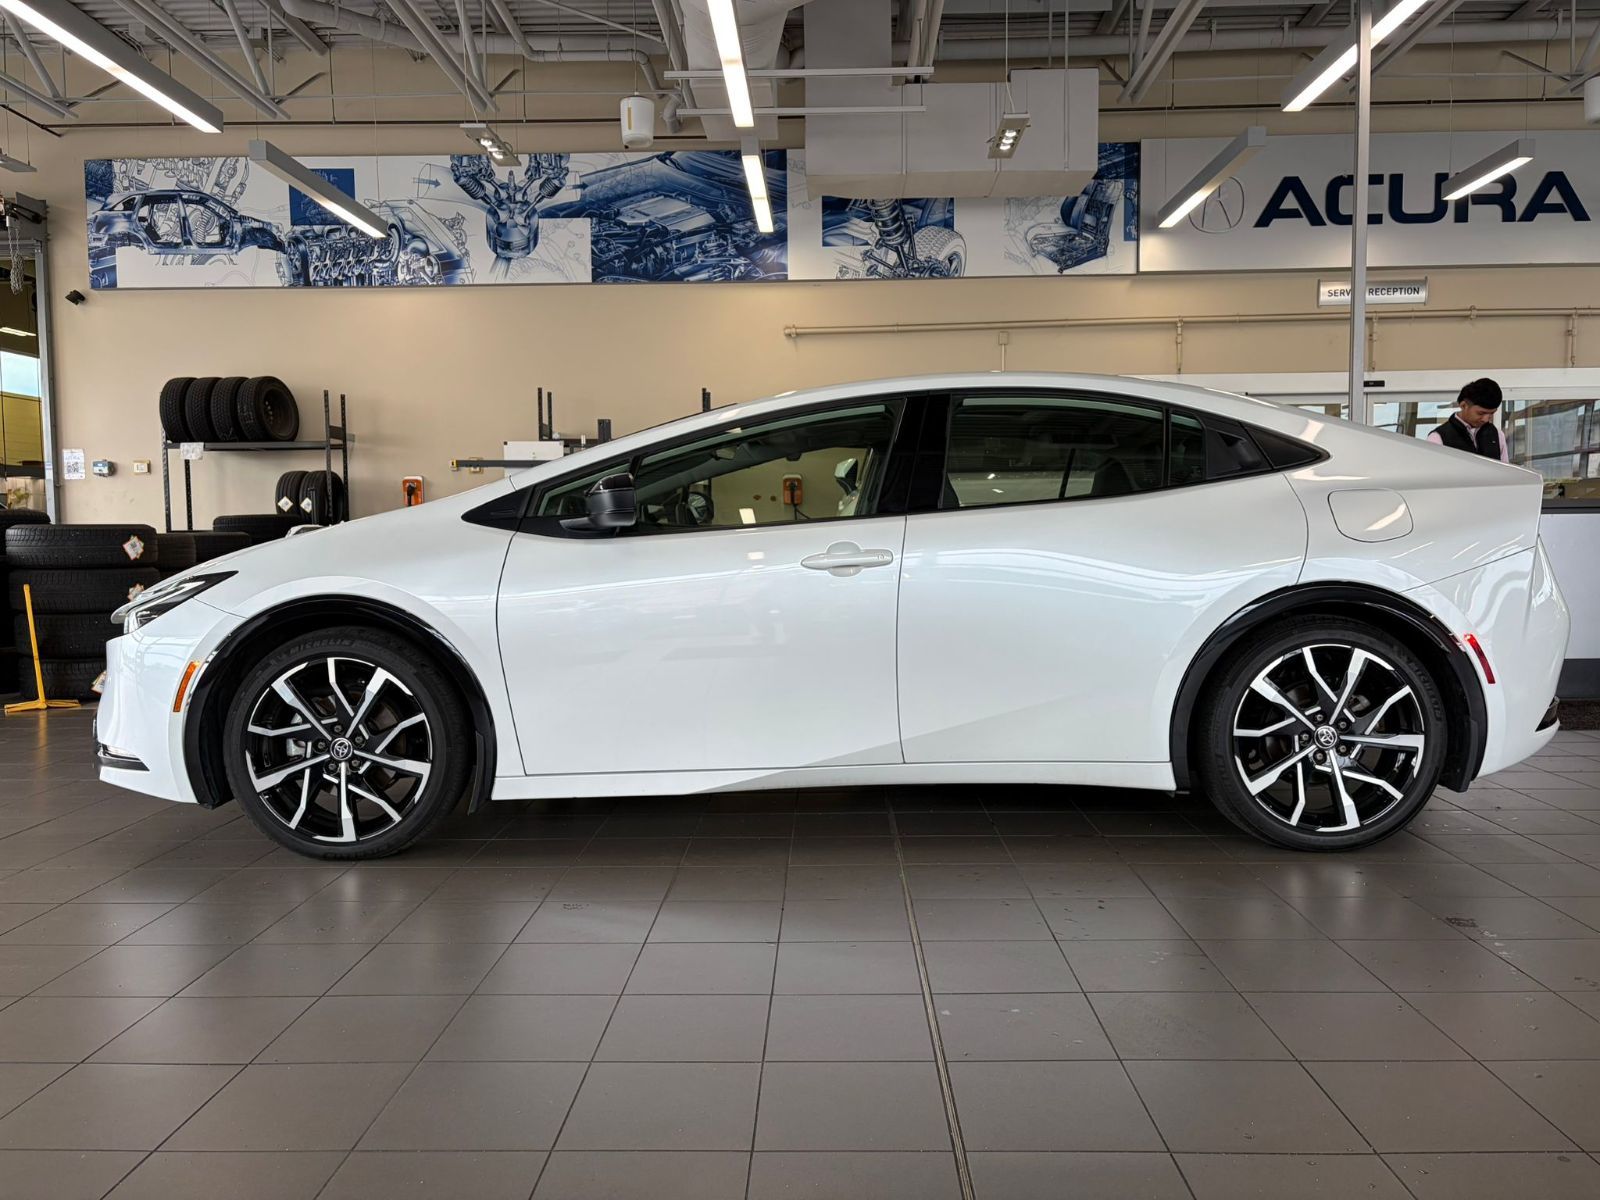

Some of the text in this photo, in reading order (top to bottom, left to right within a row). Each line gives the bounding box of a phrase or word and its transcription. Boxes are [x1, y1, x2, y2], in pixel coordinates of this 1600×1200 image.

[1253, 170, 1592, 228] ACURA
[1328, 286, 1420, 297] SERV RECEPTION
